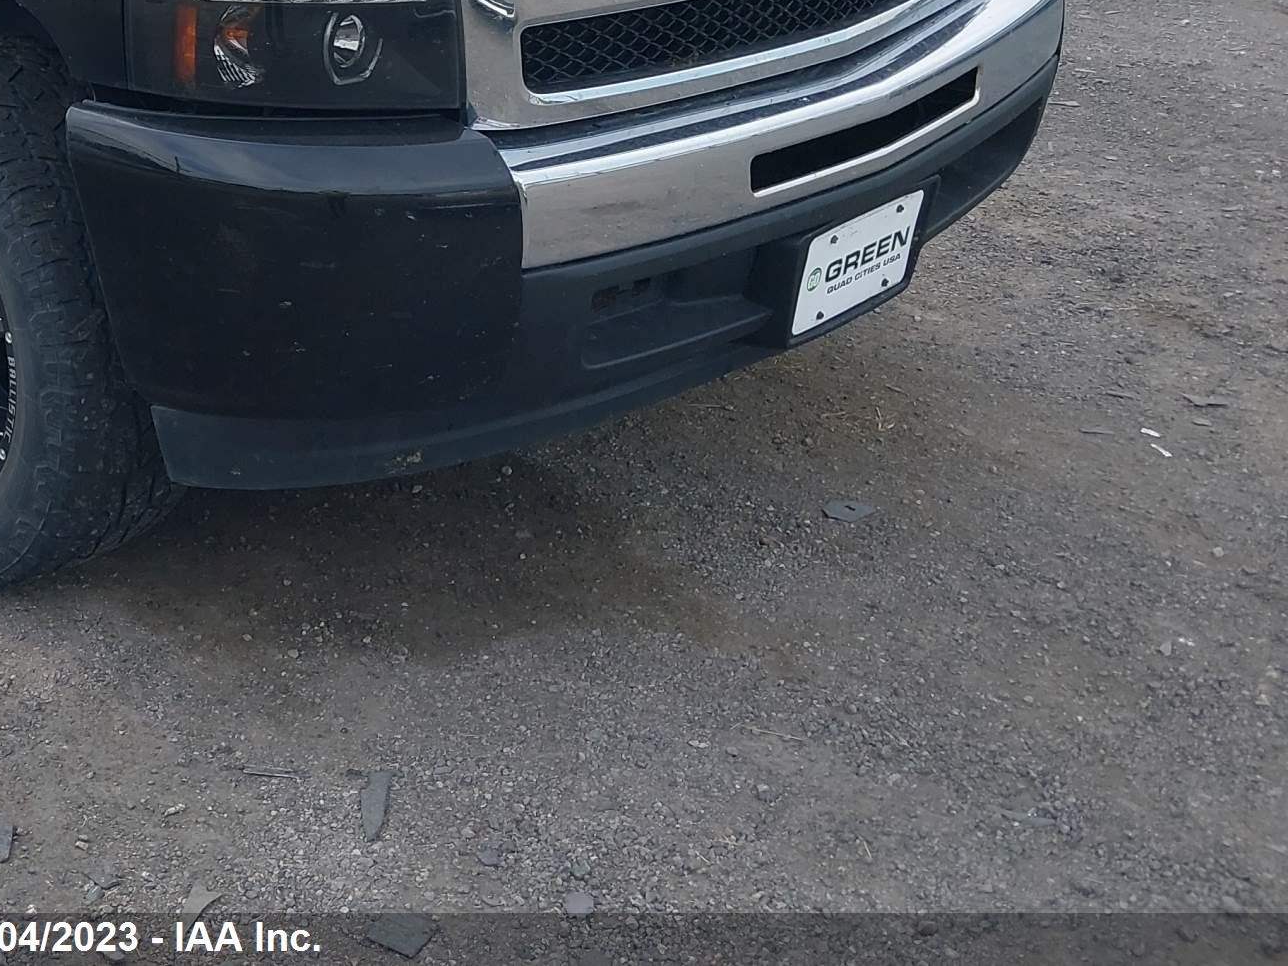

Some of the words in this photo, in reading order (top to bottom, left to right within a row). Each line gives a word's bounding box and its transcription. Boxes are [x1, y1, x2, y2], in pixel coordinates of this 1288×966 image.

[825, 225, 911, 283] GREEN
[826, 277, 853, 295] QUAD
[854, 263, 881, 281] CITIES
[883, 252, 901, 267] USA
[3, 356, 17, 444] BALLISTIC
